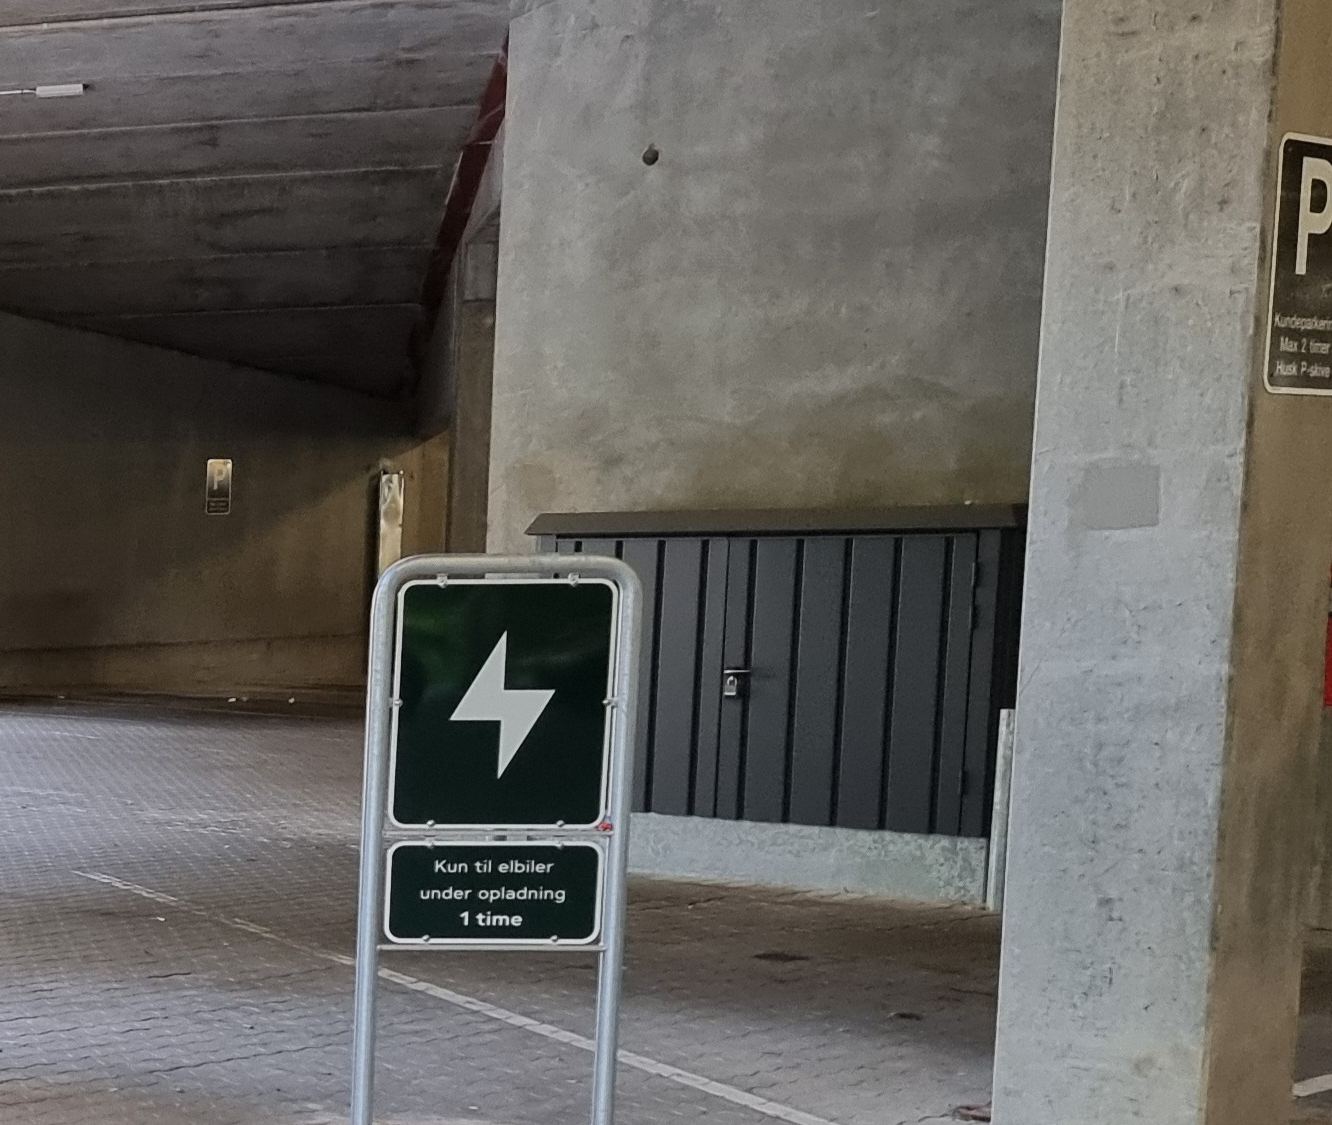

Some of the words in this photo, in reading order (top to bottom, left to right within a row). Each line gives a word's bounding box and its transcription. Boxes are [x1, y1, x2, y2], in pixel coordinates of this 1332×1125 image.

[1295, 156, 1332, 276] P
[1279, 336, 1298, 352] Max
[1301, 338, 1307, 352] 2
[1275, 361, 1298, 376] Husk
[1300, 361, 1331, 378] P-skive
[213, 462, 227, 490] P
[434, 859, 468, 873] Kun
[474, 859, 492, 873] til
[498, 859, 555, 873] elbiler
[420, 886, 473, 900] under
[478, 886, 566, 903] opladning
[459, 910, 470, 926] 1
[476, 910, 523, 926] time
